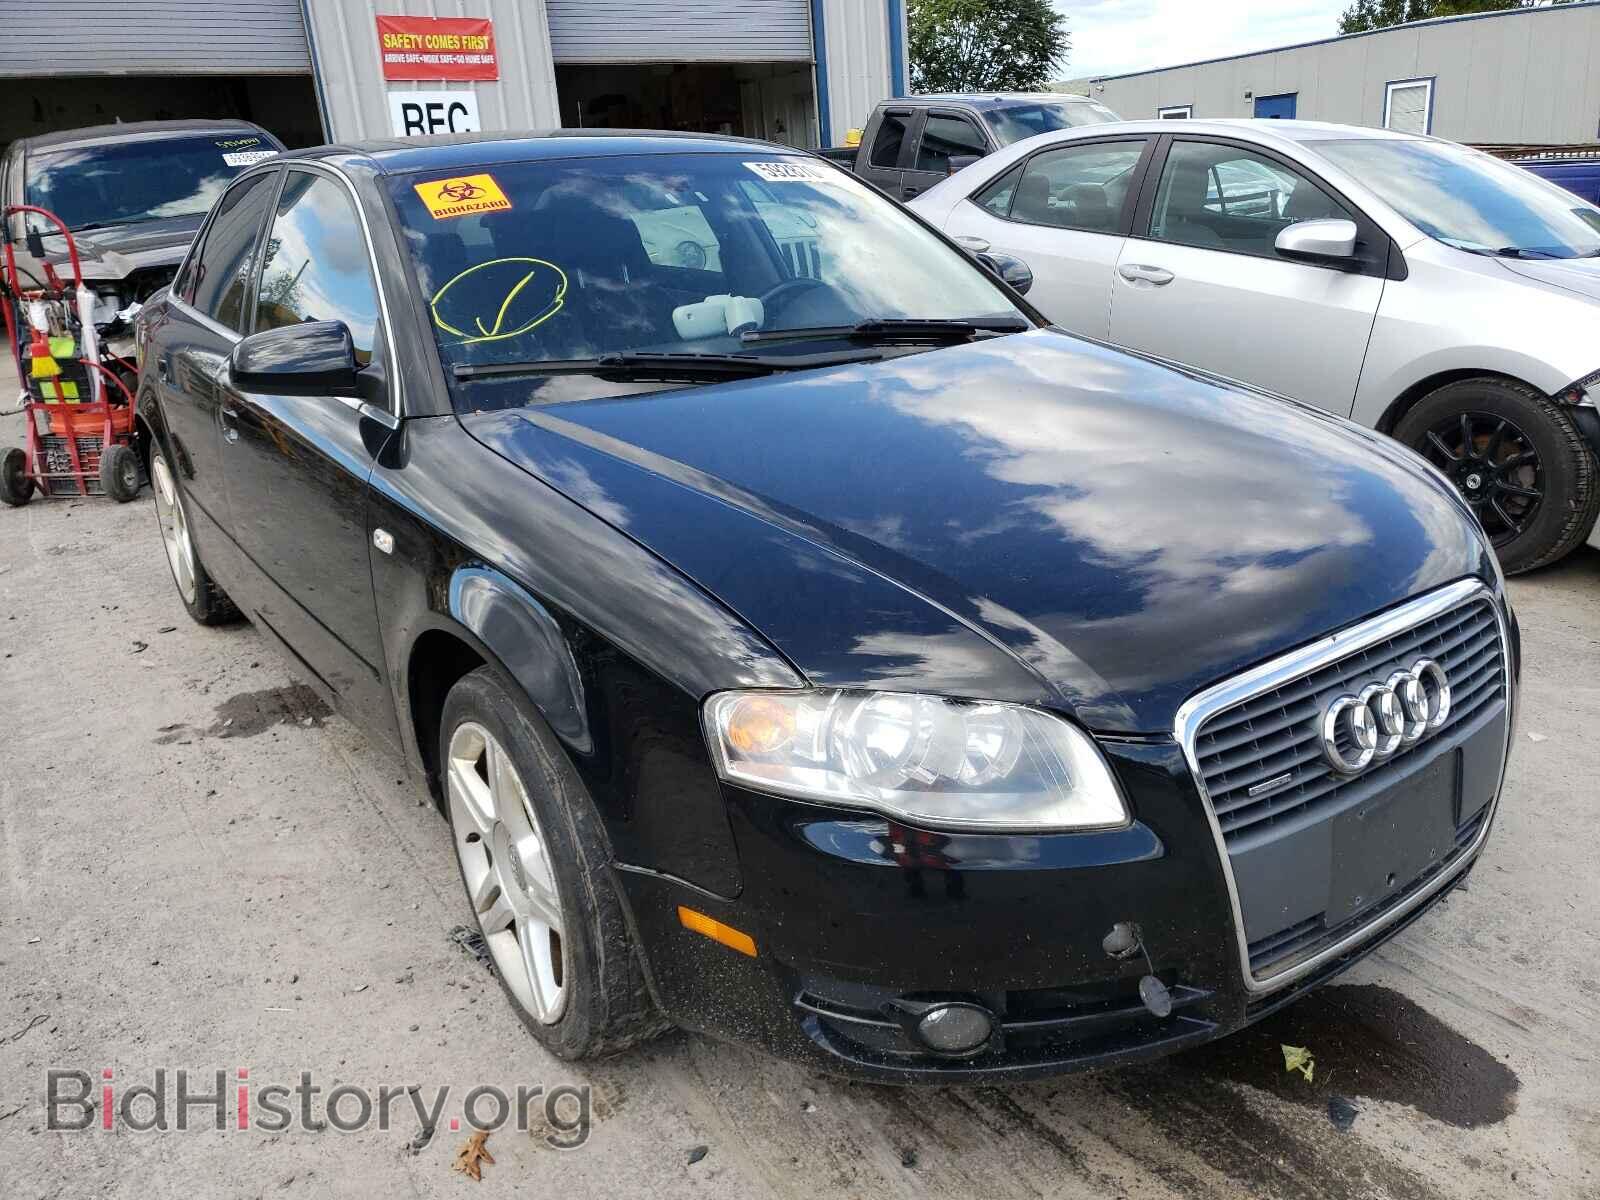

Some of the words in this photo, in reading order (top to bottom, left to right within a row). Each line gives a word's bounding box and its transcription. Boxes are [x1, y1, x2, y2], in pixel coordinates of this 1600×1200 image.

[383, 34, 424, 49] SAFETY
[425, 35, 460, 49] COMES
[462, 35, 490, 50] FIRST
[433, 199, 508, 216] BIOHAZARD
